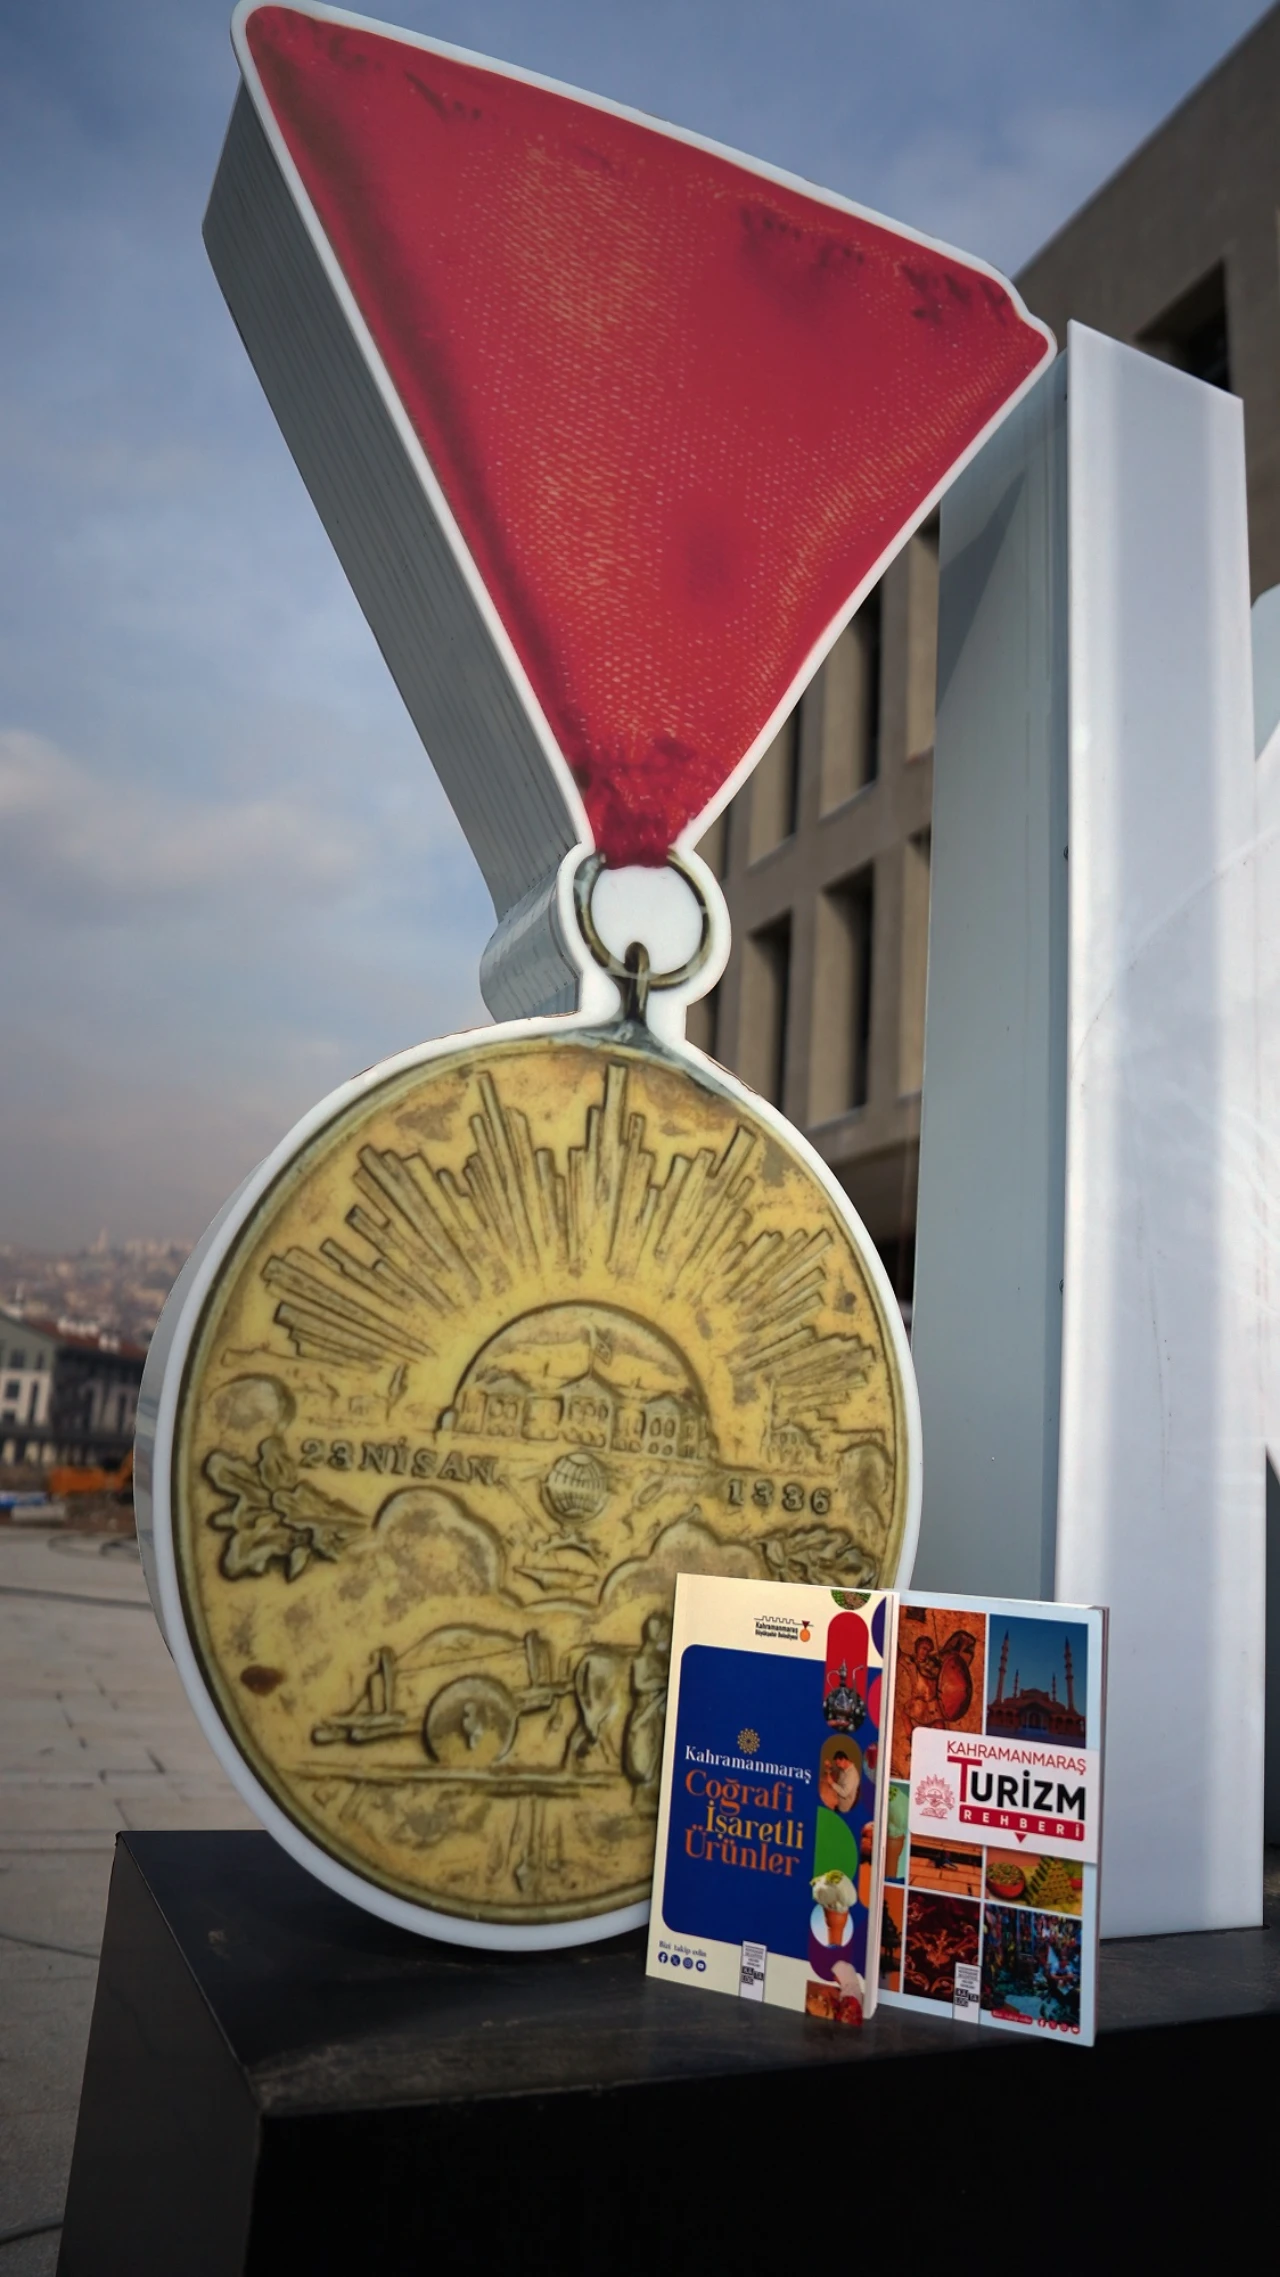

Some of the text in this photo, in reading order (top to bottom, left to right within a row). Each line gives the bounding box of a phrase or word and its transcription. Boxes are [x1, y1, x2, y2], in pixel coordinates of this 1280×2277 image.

[685, 1745, 812, 1784] Kahramanmaraş
[947, 1740, 1087, 1776] KAHRAMANMARAŞ
[685, 1769, 794, 1816] Coğrafi
[947, 1755, 1086, 1821] TURİZM
[706, 1799, 804, 1850] İşaretli
[963, 1810, 1081, 1838] REHBERİ
[685, 1823, 800, 1876] Ürünler
